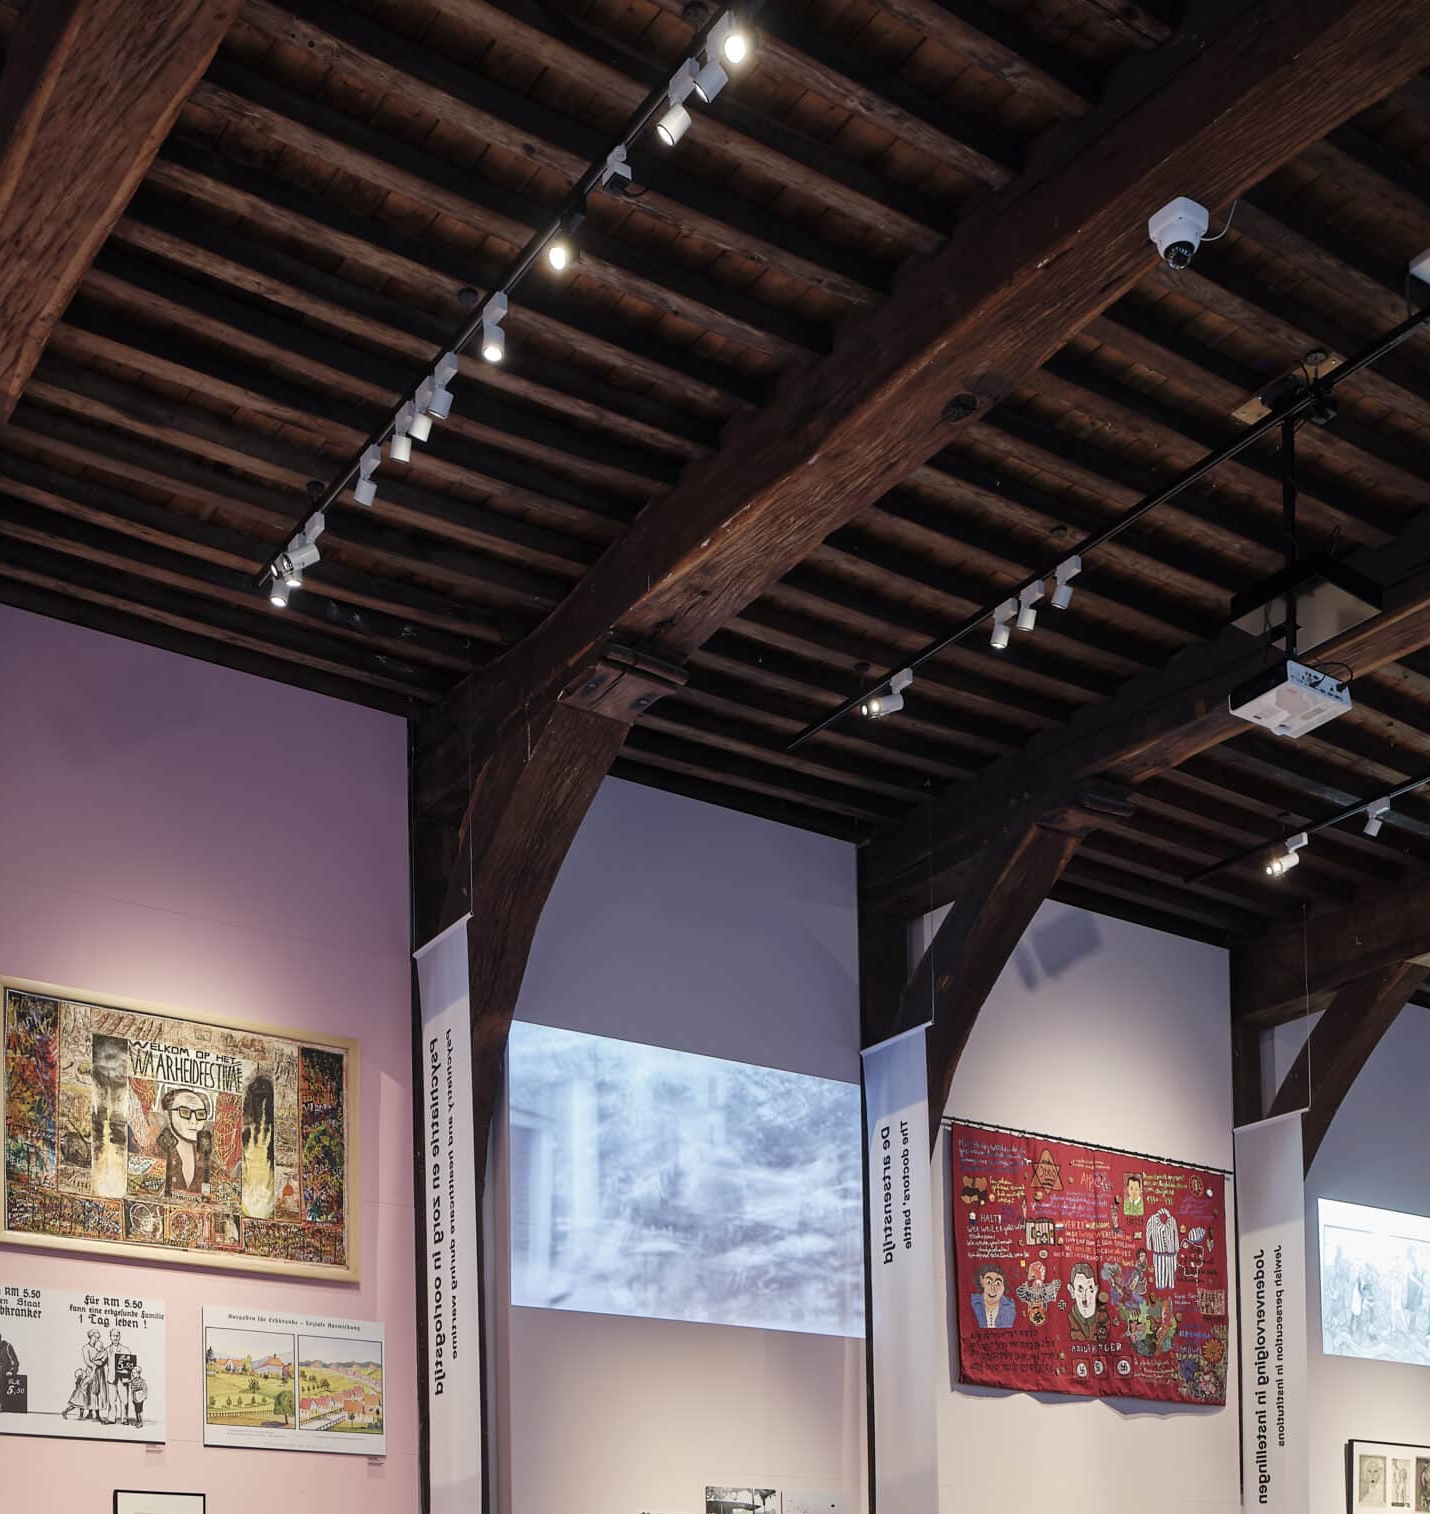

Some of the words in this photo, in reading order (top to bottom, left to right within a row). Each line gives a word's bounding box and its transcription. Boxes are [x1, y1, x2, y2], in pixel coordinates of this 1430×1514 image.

[128, 1040, 190, 1057] WELKOM
[196, 1050, 211, 1060] OP
[216, 1054, 236, 1064] HET
[4, 1288, 19, 1297] RM
[23, 1289, 41, 1299] 5.50
[103, 1298, 120, 1307] RM
[124, 1299, 143, 1309] 5.50
[88, 1314, 110, 1327] Tag
